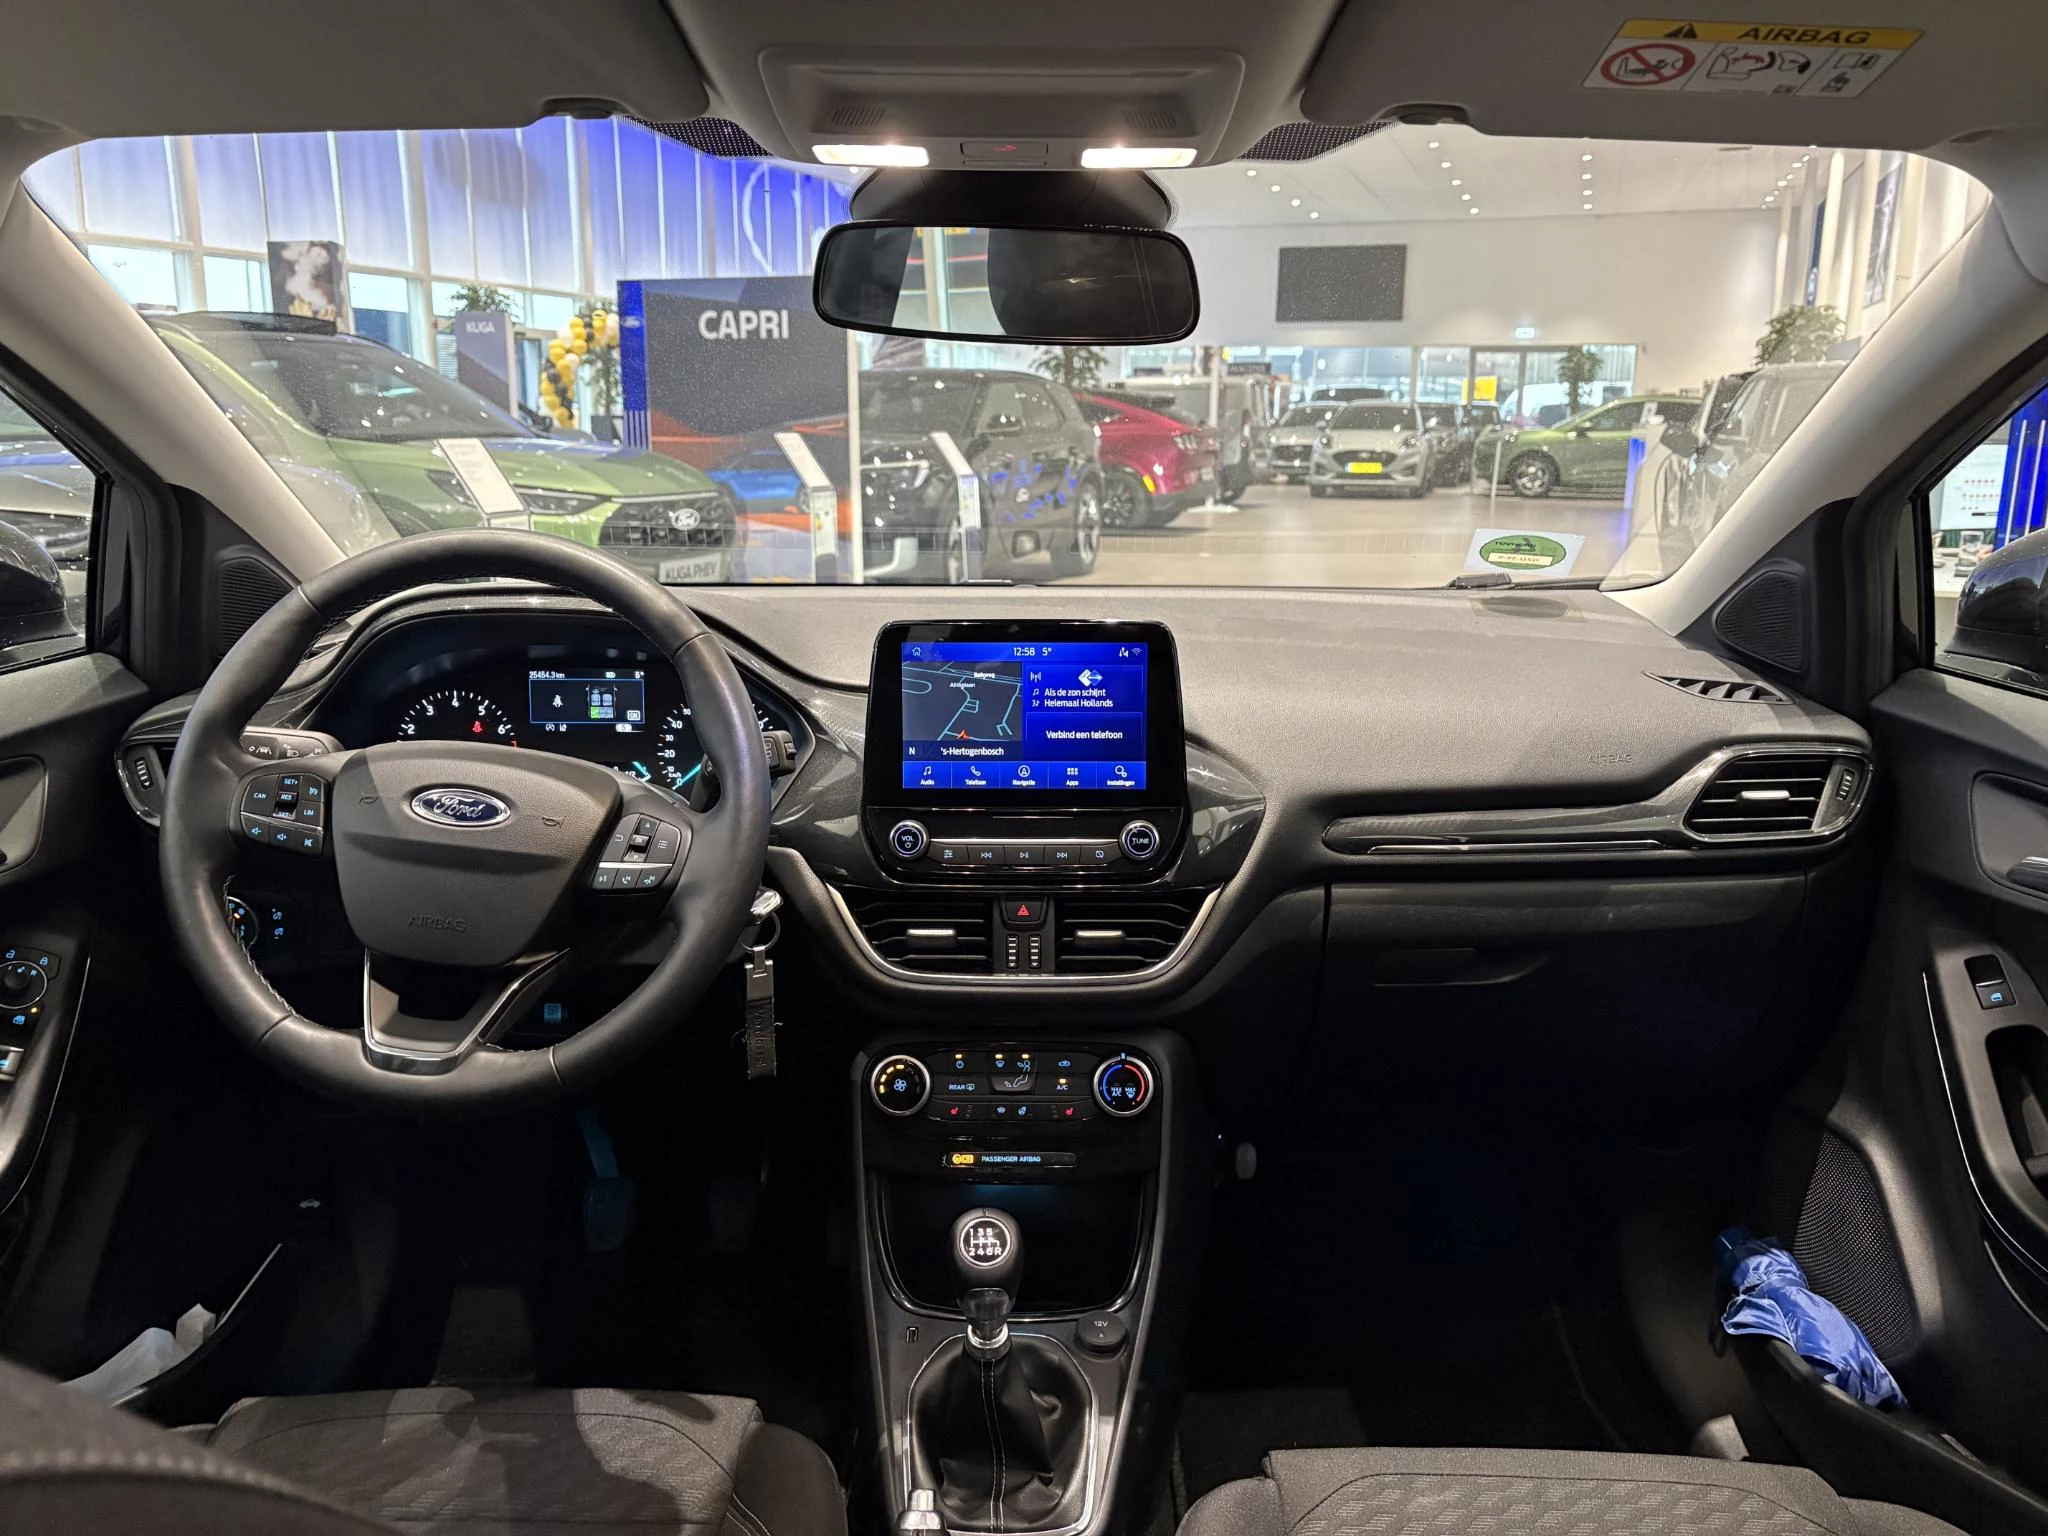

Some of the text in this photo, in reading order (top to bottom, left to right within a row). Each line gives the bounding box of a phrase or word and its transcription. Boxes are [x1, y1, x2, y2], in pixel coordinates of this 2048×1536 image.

[1737, 26, 1873, 45] AIRBAG
[465, 320, 496, 334] KUGA
[698, 308, 790, 340] CAPRI
[665, 563, 692, 580] KUGA
[1013, 647, 1052, 656] 12:58 5°
[528, 670, 566, 679] 25454.3 km
[1044, 688, 1106, 698] Als de zon schijnt
[451, 697, 460, 708] 4
[1044, 699, 1114, 708] Helemaal Hollands
[425, 705, 434, 716] 3
[478, 705, 486, 716] 5
[407, 723, 416, 735] 2
[497, 724, 506, 735] 6
[671, 720, 683, 729] 40
[665, 734, 674, 742] 30
[1046, 730, 1075, 739] Verbind
[1091, 730, 1123, 739] telefoon
[664, 749, 676, 758] 20
[908, 746, 916, 755] N
[940, 747, 1005, 757] 's-Hertogenbosch
[1588, 753, 1634, 764] AIRBAG
[1012, 779, 1036, 787] Navigatie
[1066, 779, 1079, 787] Apps
[1107, 779, 1135, 787] Instellingen
[434, 795, 486, 818] Ford
[1131, 836, 1150, 845] TUNE
[407, 914, 467, 933] AIRBAG
